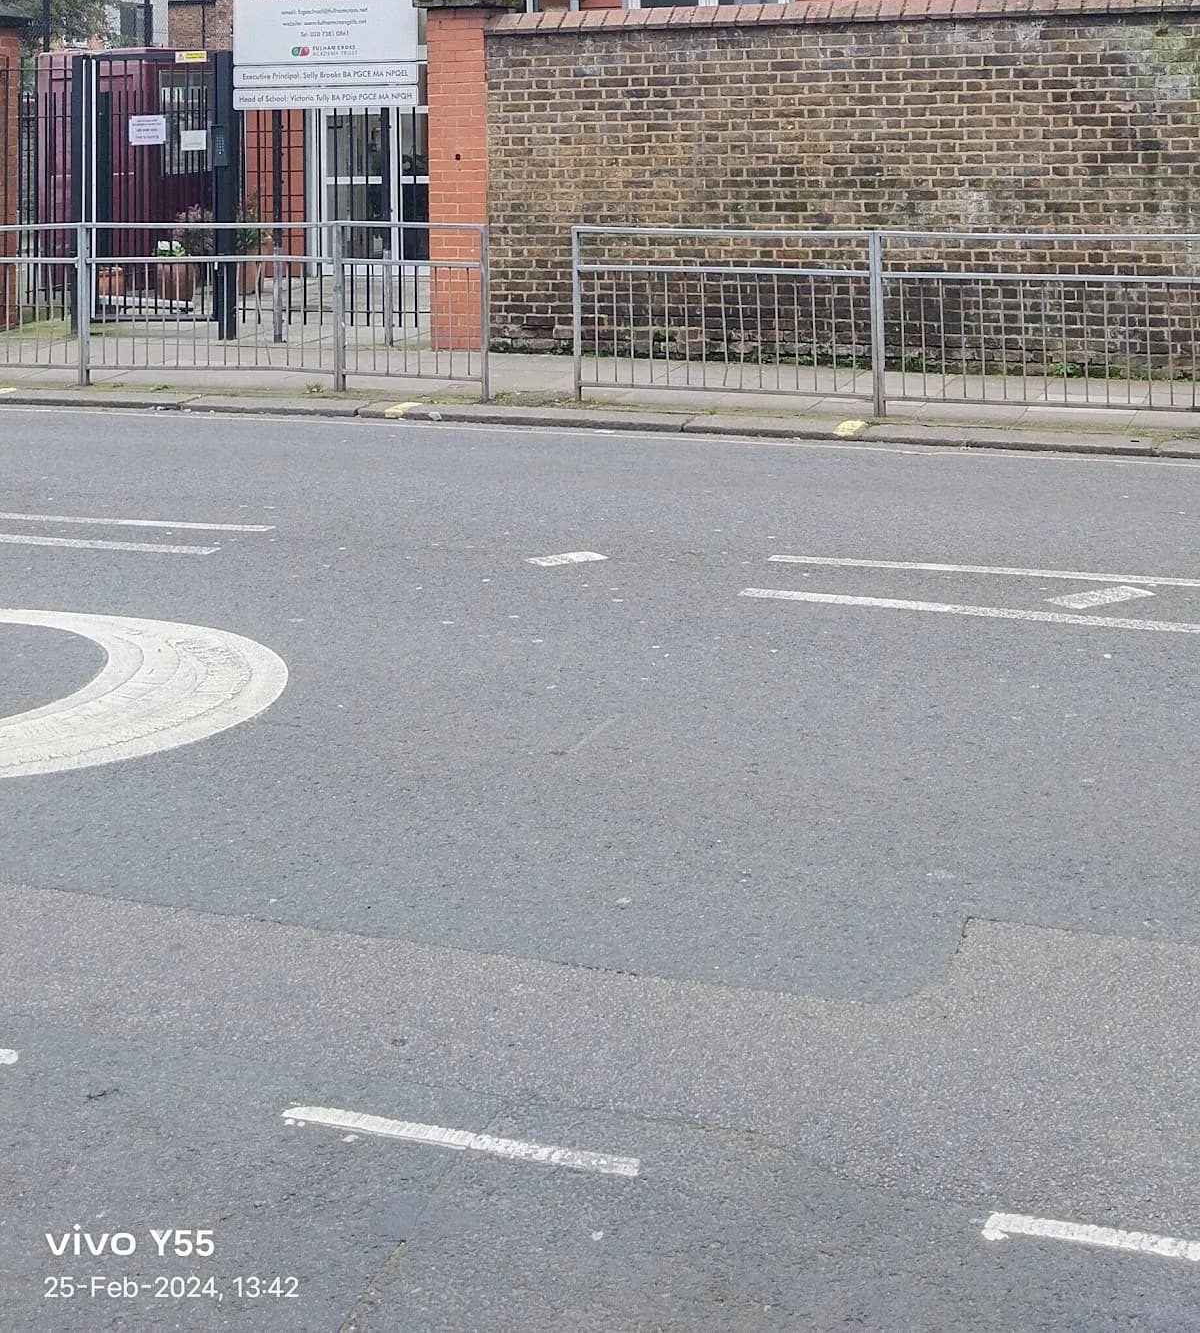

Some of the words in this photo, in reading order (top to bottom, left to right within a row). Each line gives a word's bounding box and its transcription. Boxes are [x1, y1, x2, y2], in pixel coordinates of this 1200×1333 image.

[242, 73, 271, 81] Executive
[303, 71, 318, 80] Sally
[320, 70, 341, 78] Brooks
[343, 70, 352, 78] BA
[353, 70, 371, 78] PGCE
[373, 69, 384, 77] MA
[385, 69, 408, 77] NPQEL
[239, 95, 256, 103] Head
[257, 95, 264, 103] of
[265, 94, 288, 103] School:
[290, 93, 314, 102] Victoria
[316, 93, 330, 103] Tully
[331, 93, 341, 101] BA
[342, 92, 357, 102] PDip
[358, 92, 377, 101] PGCE
[378, 92, 390, 100] MA
[391, 91, 412, 100] NPQH
